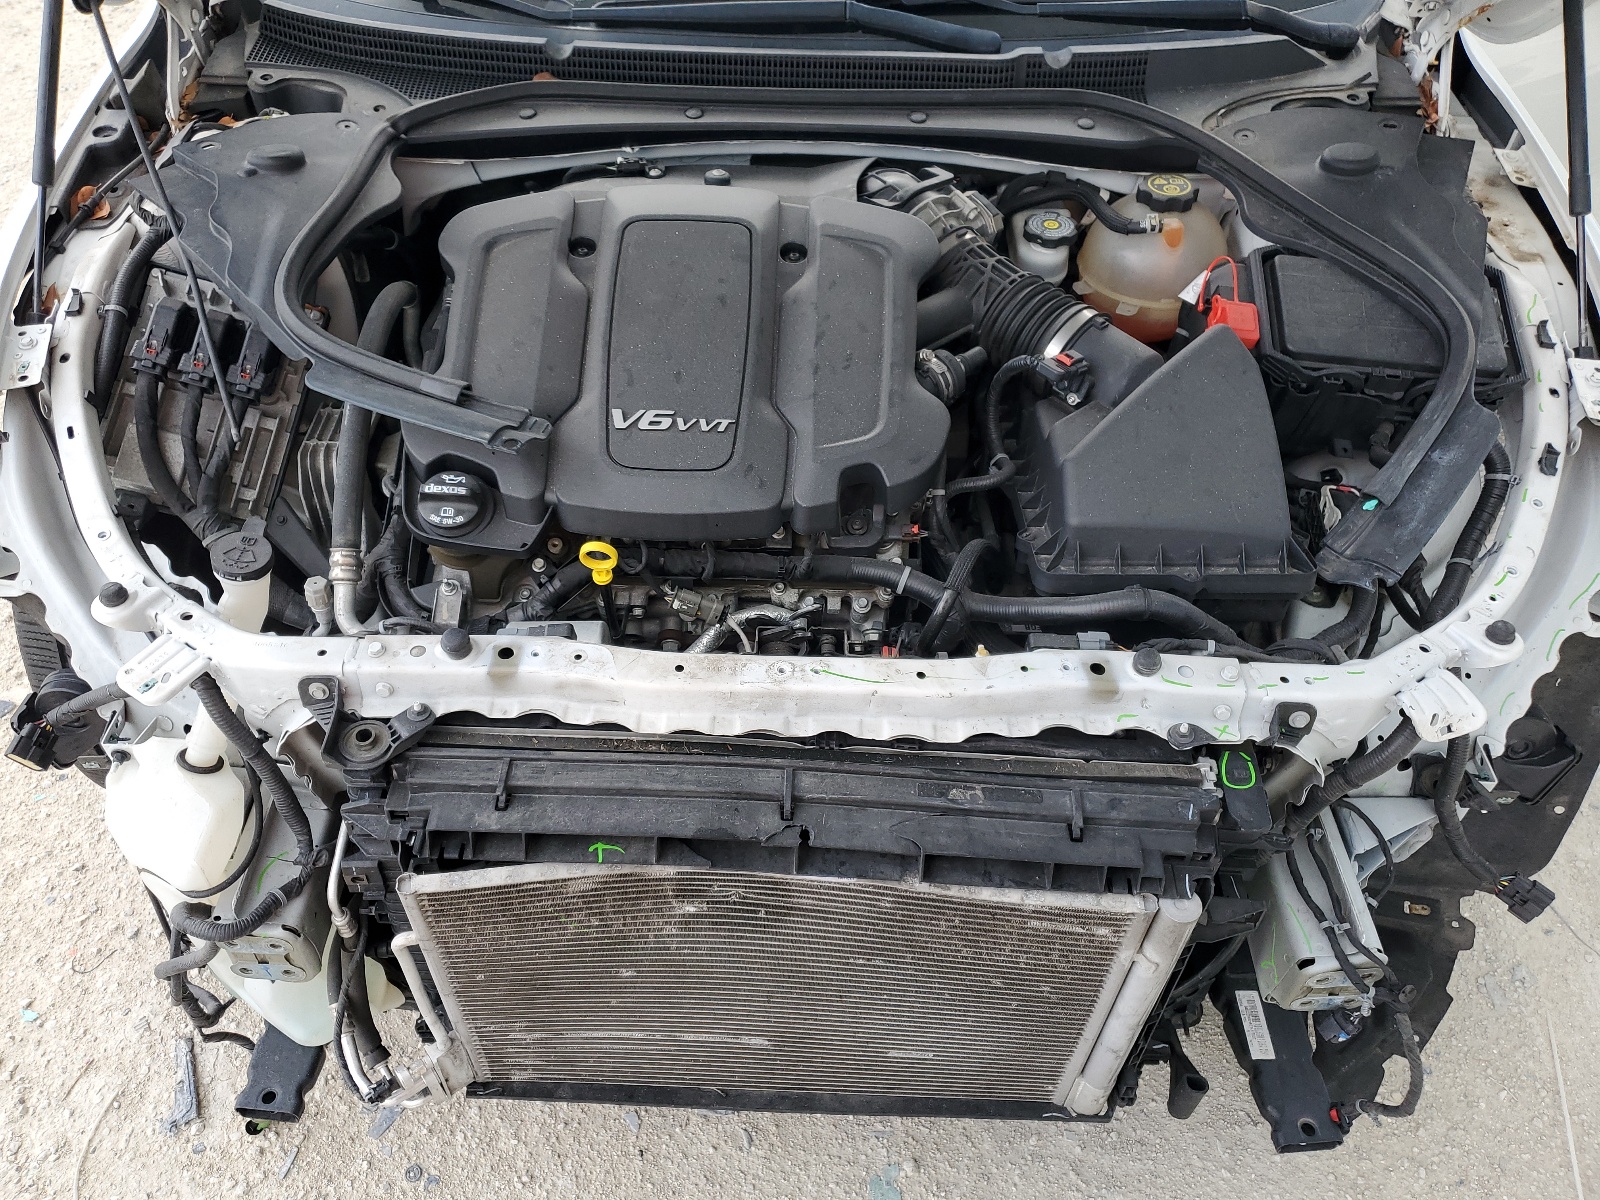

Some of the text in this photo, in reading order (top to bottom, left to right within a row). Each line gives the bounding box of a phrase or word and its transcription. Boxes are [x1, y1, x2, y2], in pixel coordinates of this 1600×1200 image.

[611, 408, 736, 433] V6 VVT
[424, 483, 469, 495] dexos
[429, 513, 442, 524] SAE
